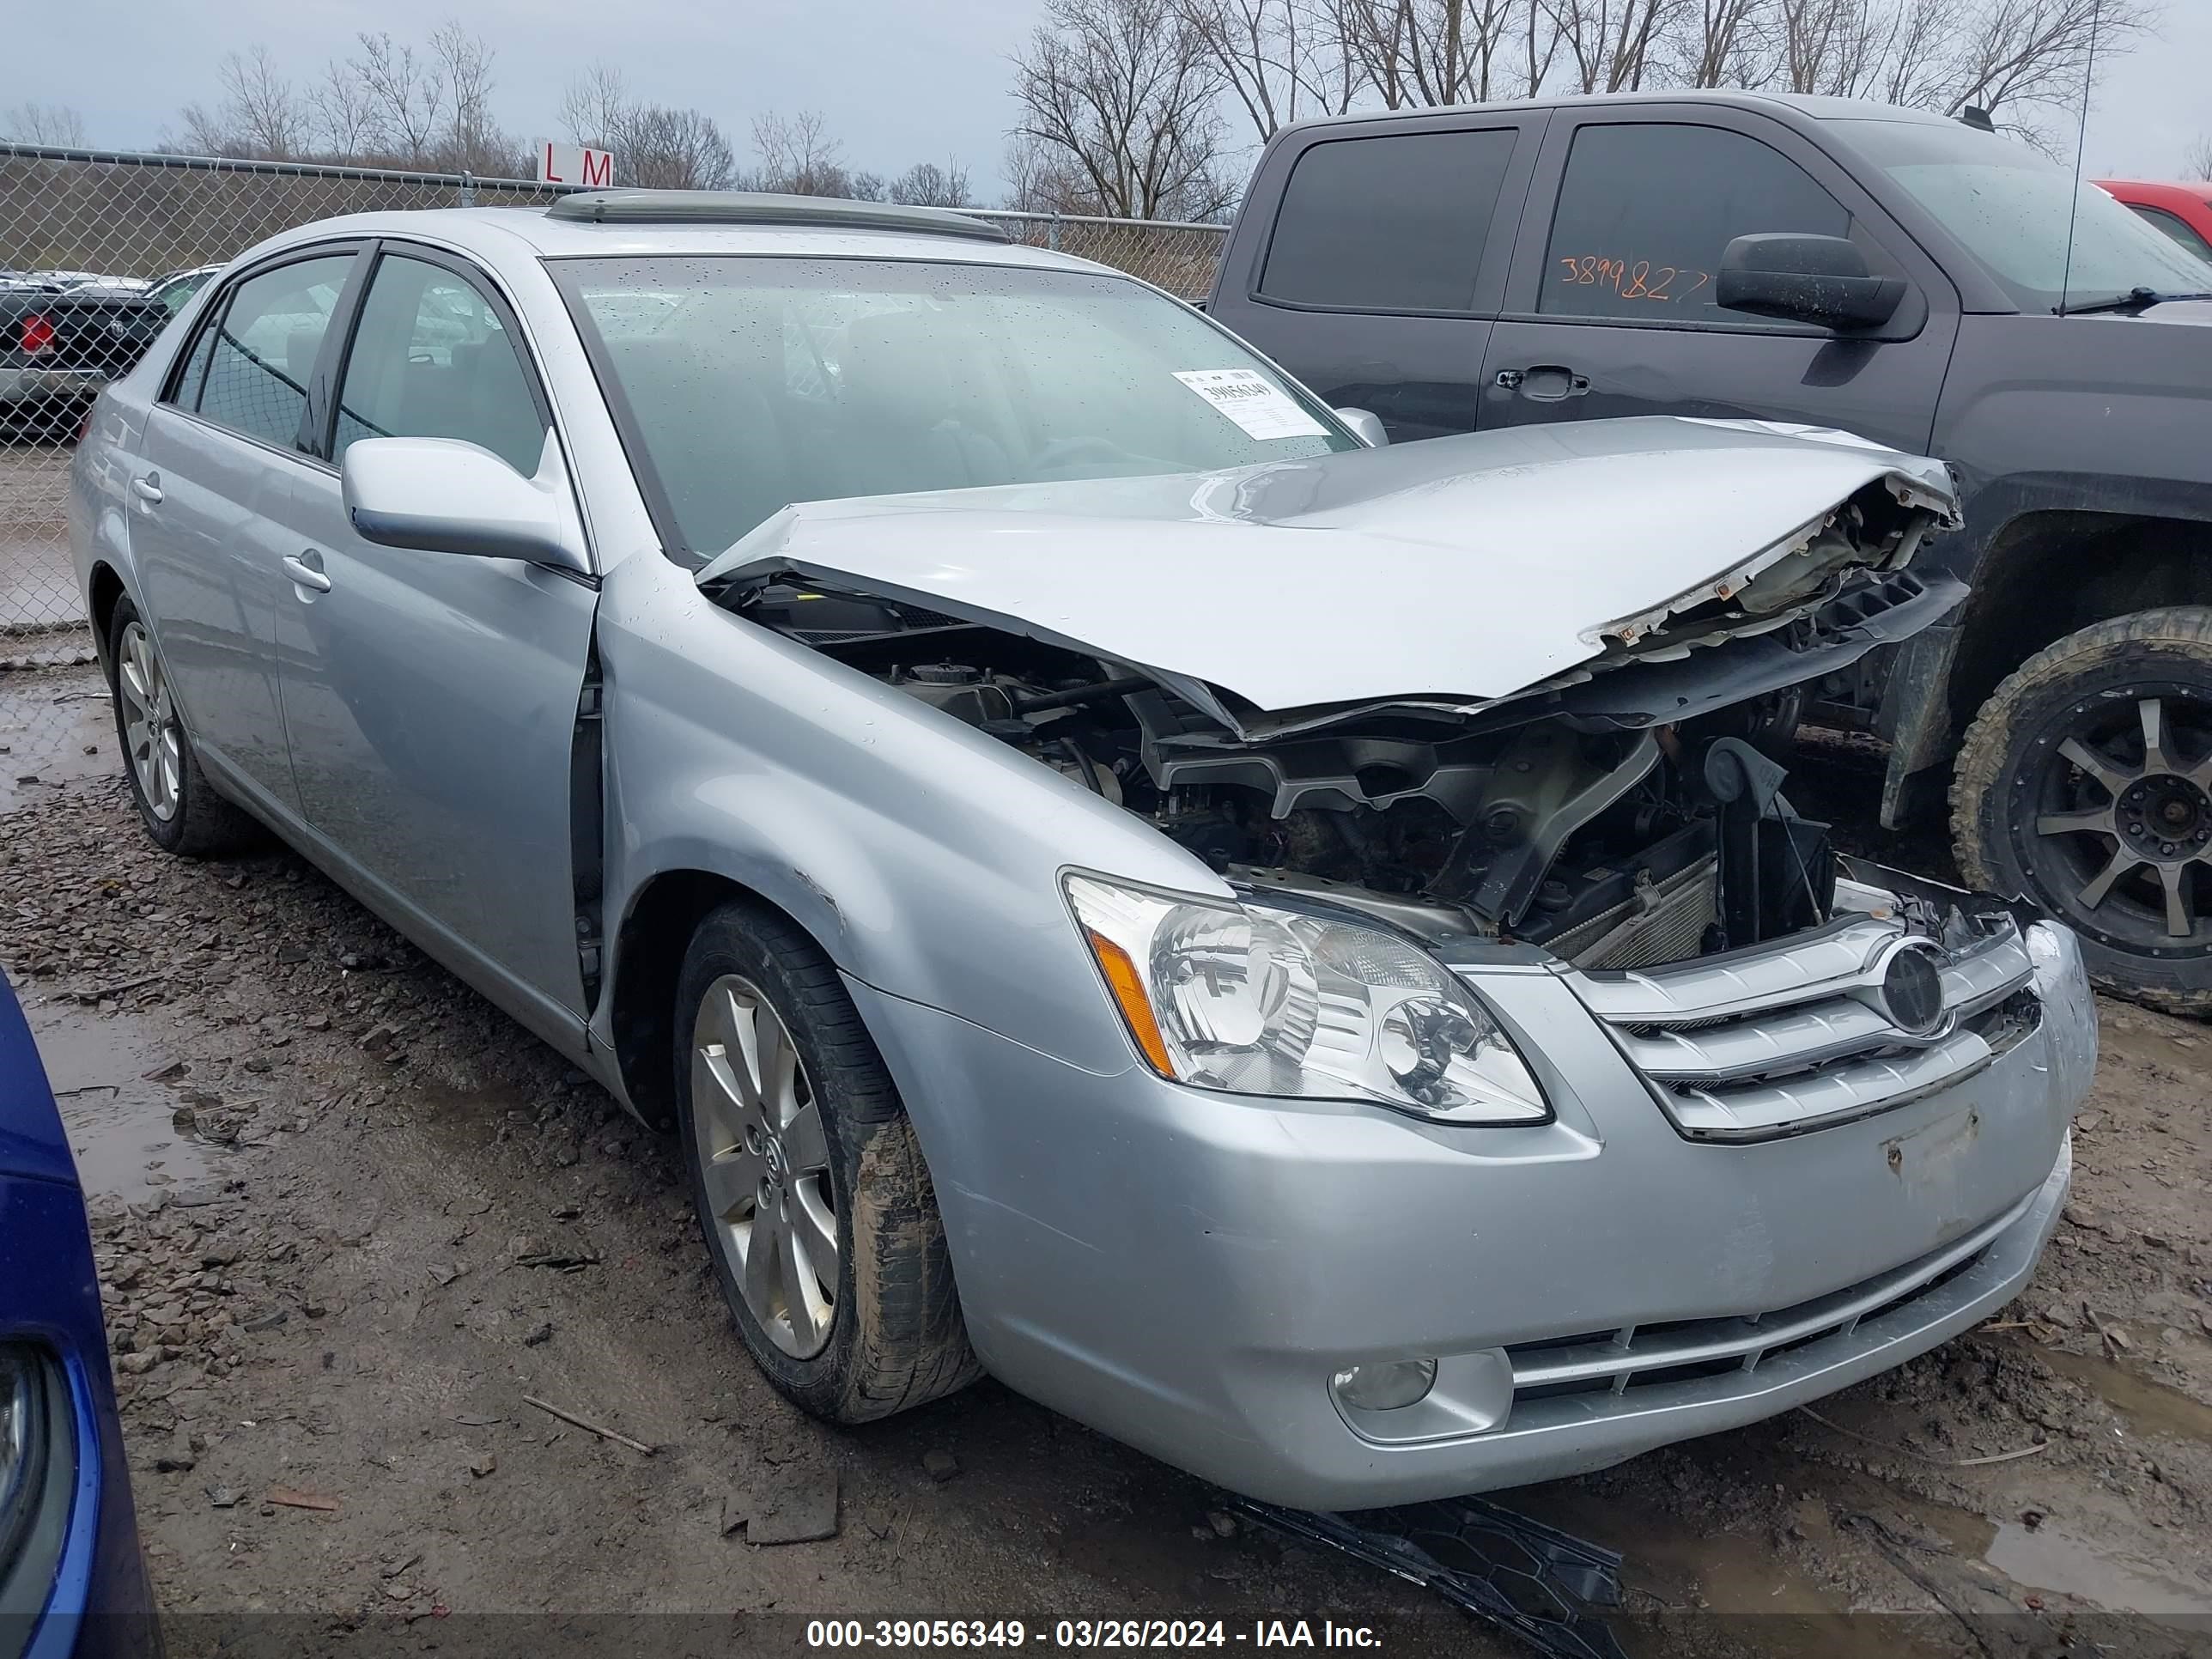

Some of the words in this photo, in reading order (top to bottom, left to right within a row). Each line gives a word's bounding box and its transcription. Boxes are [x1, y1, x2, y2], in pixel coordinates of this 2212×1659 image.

[546, 143, 563, 182] L
[582, 150, 611, 186] M
[1560, 256, 1717, 306] 3899827
[1204, 383, 1271, 400] 39056349
